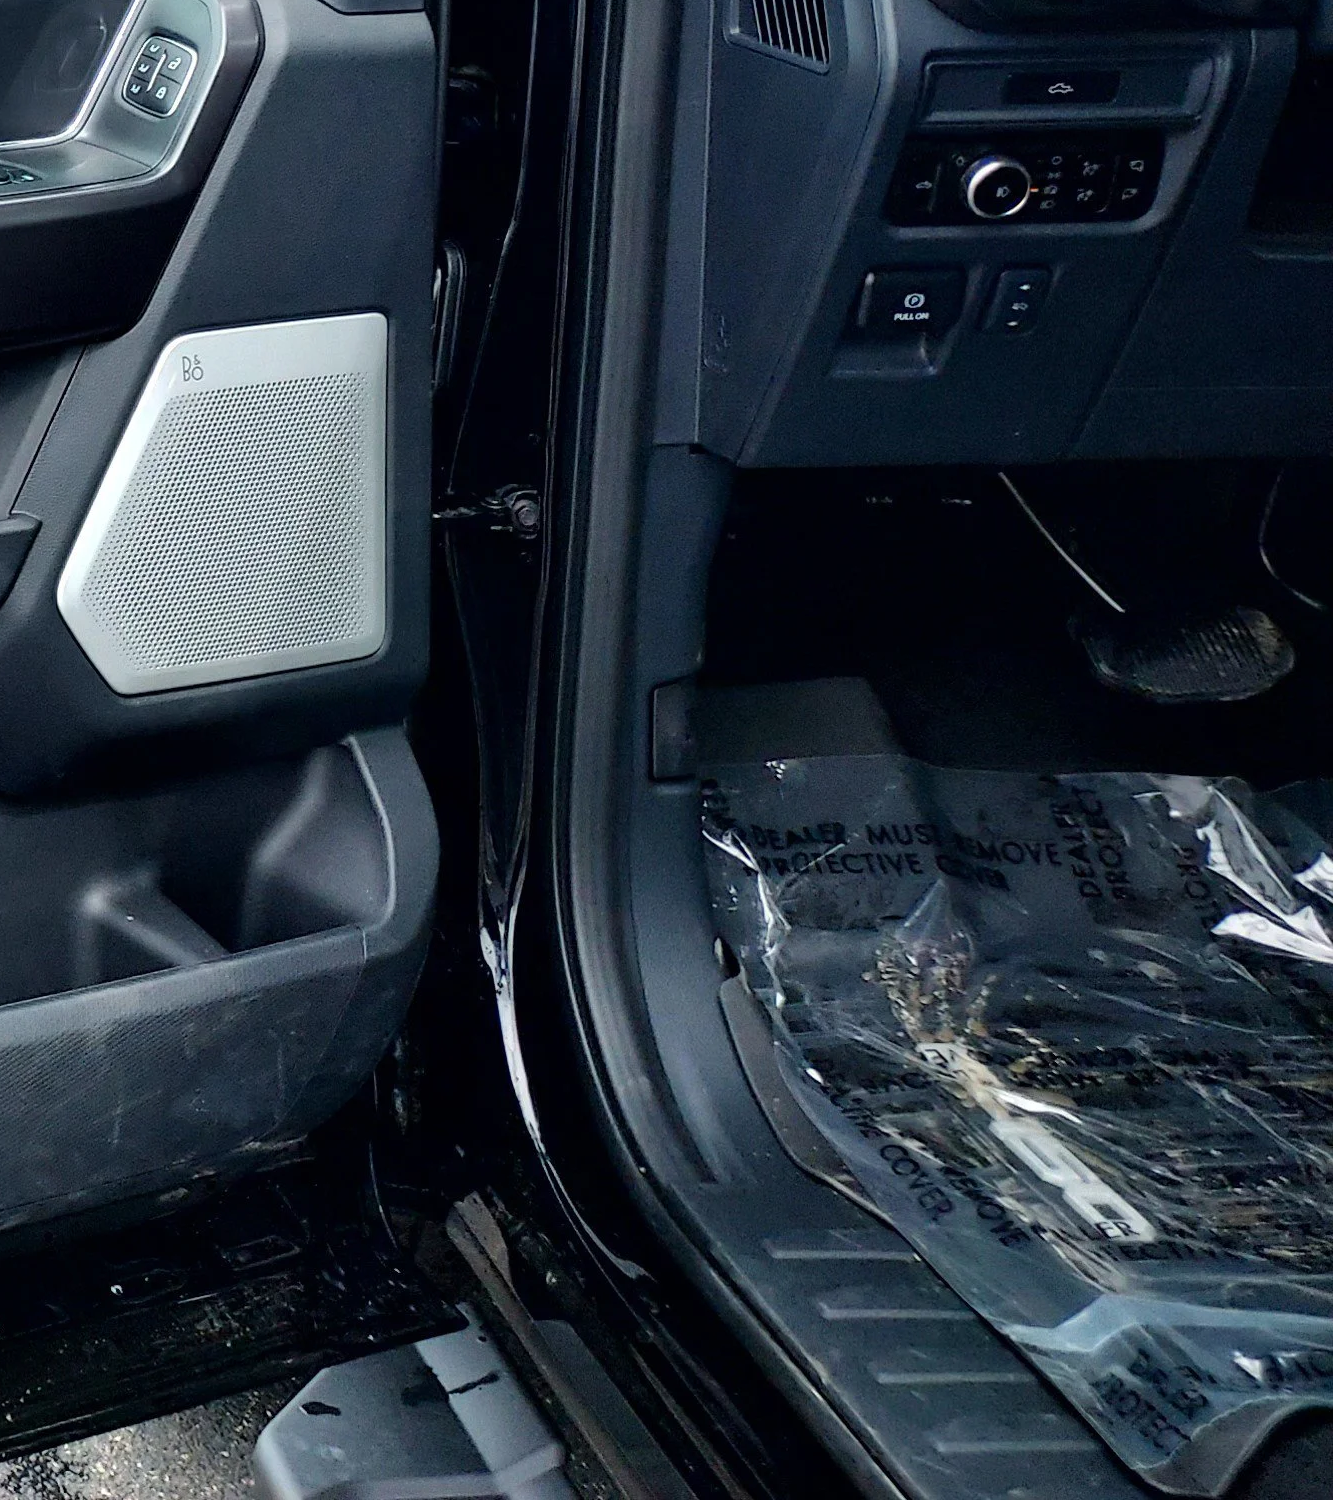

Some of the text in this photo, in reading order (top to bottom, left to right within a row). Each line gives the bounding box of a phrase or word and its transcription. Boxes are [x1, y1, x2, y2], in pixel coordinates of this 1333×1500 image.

[893, 312, 930, 321] PULL ON
[880, 1143, 955, 1224] COVER
